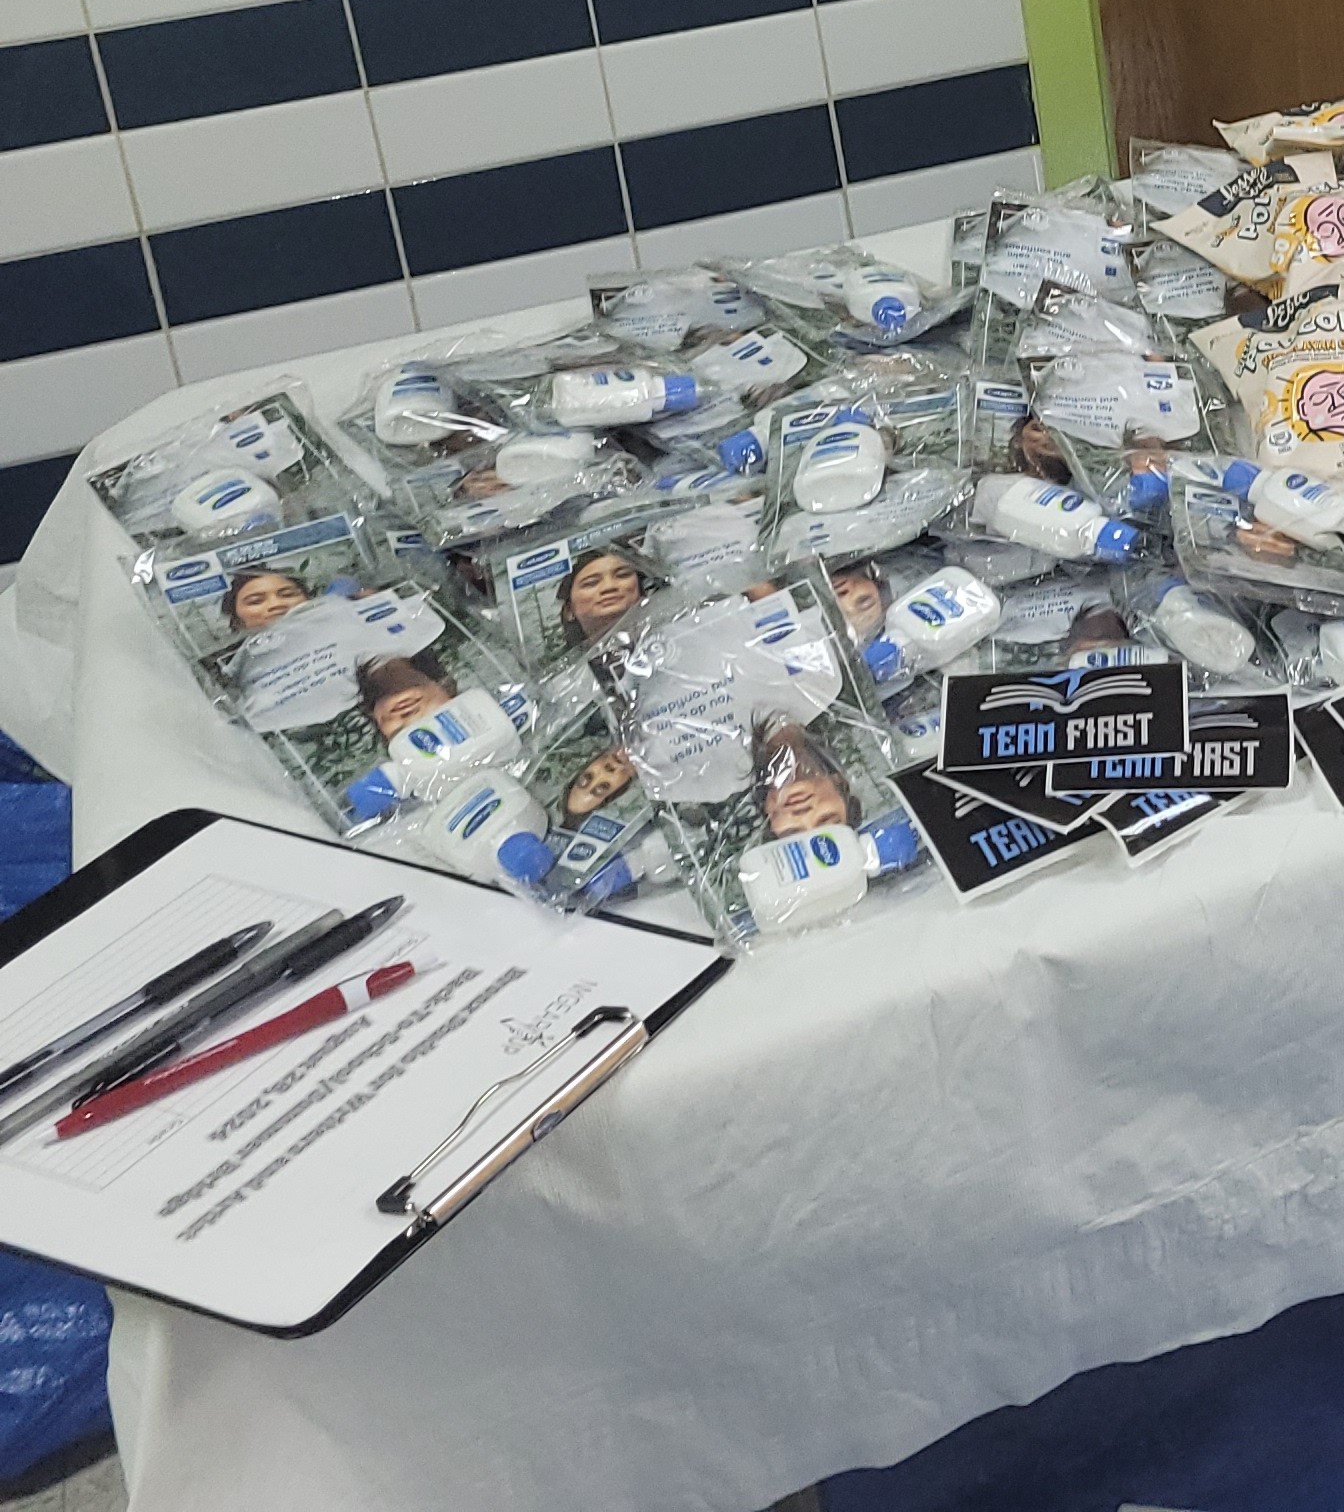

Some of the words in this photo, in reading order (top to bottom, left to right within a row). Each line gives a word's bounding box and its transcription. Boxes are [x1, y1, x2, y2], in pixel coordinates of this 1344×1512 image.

[689, 702, 708, 719] do
[707, 690, 734, 711] You
[654, 710, 688, 732] clm
[978, 721, 1056, 758] TEAM
[1066, 712, 1153, 750] FIRST
[1173, 740, 1260, 777] FIRST
